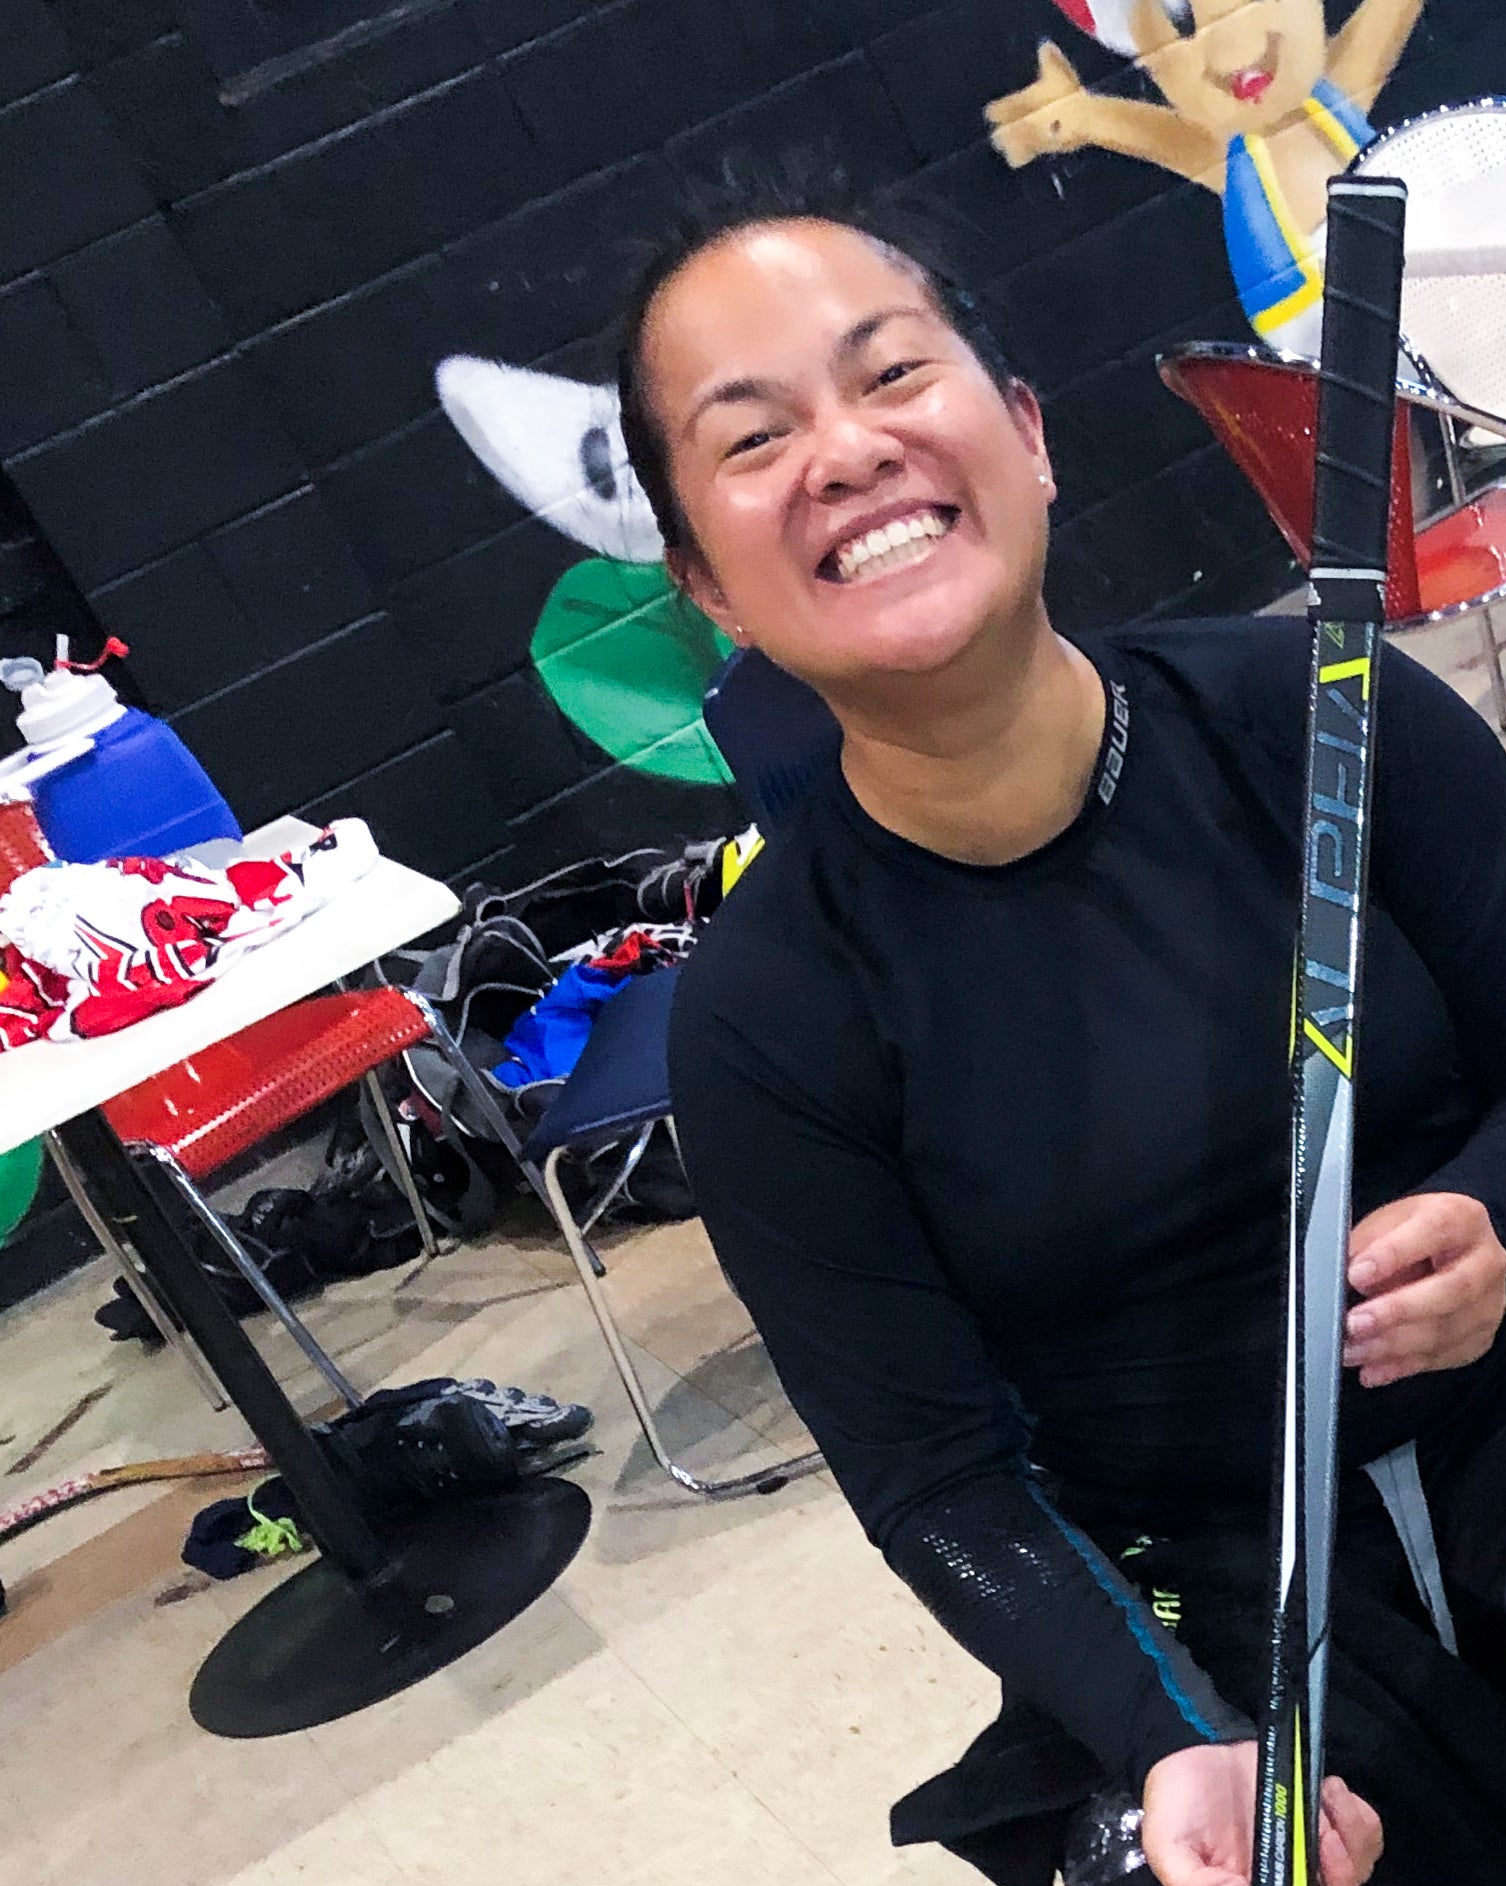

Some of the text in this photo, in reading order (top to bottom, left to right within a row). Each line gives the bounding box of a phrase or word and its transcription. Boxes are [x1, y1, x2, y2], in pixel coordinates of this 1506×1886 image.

[1098, 679, 1130, 806] BAUER
[1303, 657, 1371, 1078] ALPHA
[1274, 1783, 1287, 1819] 1000
[1274, 1818, 1286, 1862] CARBON
